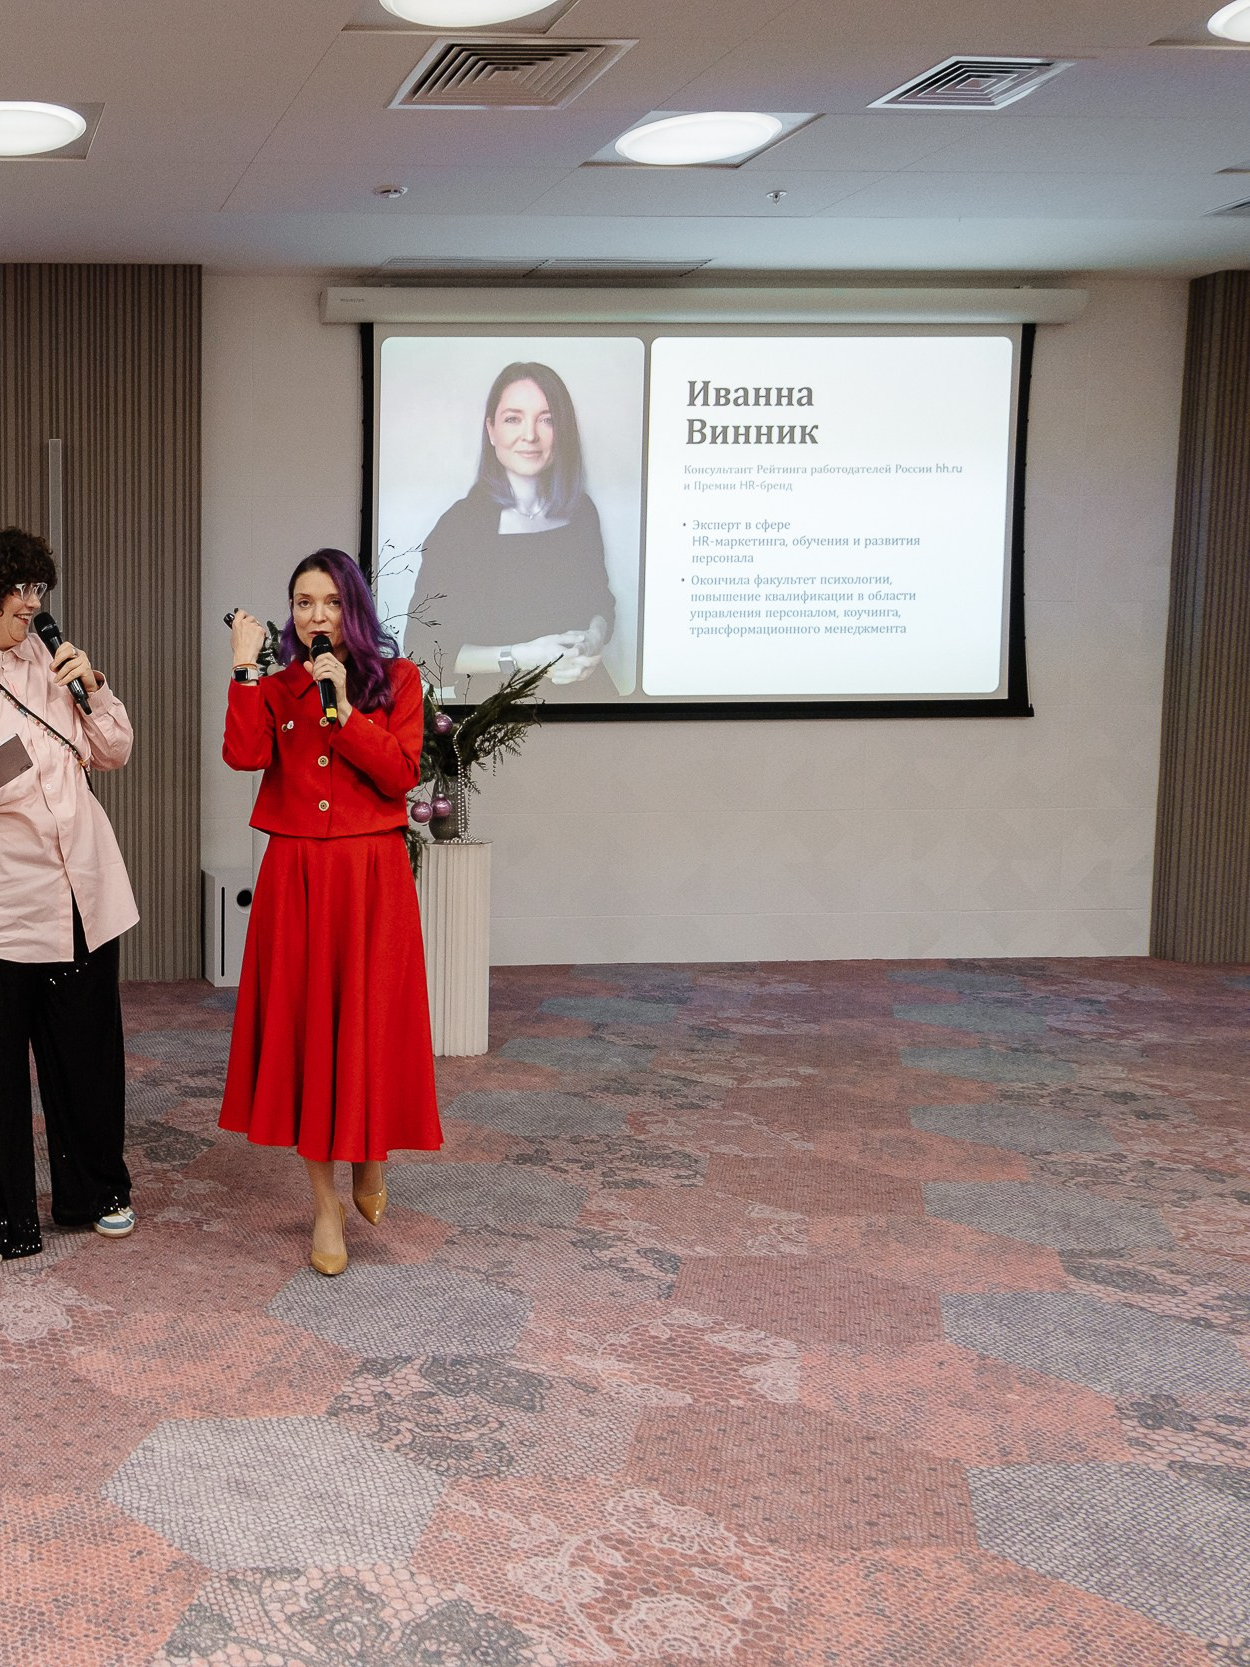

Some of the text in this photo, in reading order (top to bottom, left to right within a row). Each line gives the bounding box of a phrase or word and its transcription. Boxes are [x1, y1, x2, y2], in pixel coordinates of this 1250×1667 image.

[687, 380, 815, 407] Иванна
[686, 418, 819, 444] Винник
[685, 462, 963, 476] Консультант Рейтинга работодателей России hh.ru
[694, 480, 737, 492] Премии
[740, 479, 794, 493] HR-бренд
[693, 518, 791, 533] Эксперт в сфере
[693, 535, 921, 549] HR-маркетинга, обучения и развития
[692, 554, 754, 566] персонала
[691, 573, 893, 588] Окончила факультет психологии,
[691, 589, 917, 604] повышение квалификации в области
[690, 608, 902, 621] управления персоналом, коучинга,
[690, 623, 907, 638] трансформационного менеджмента
